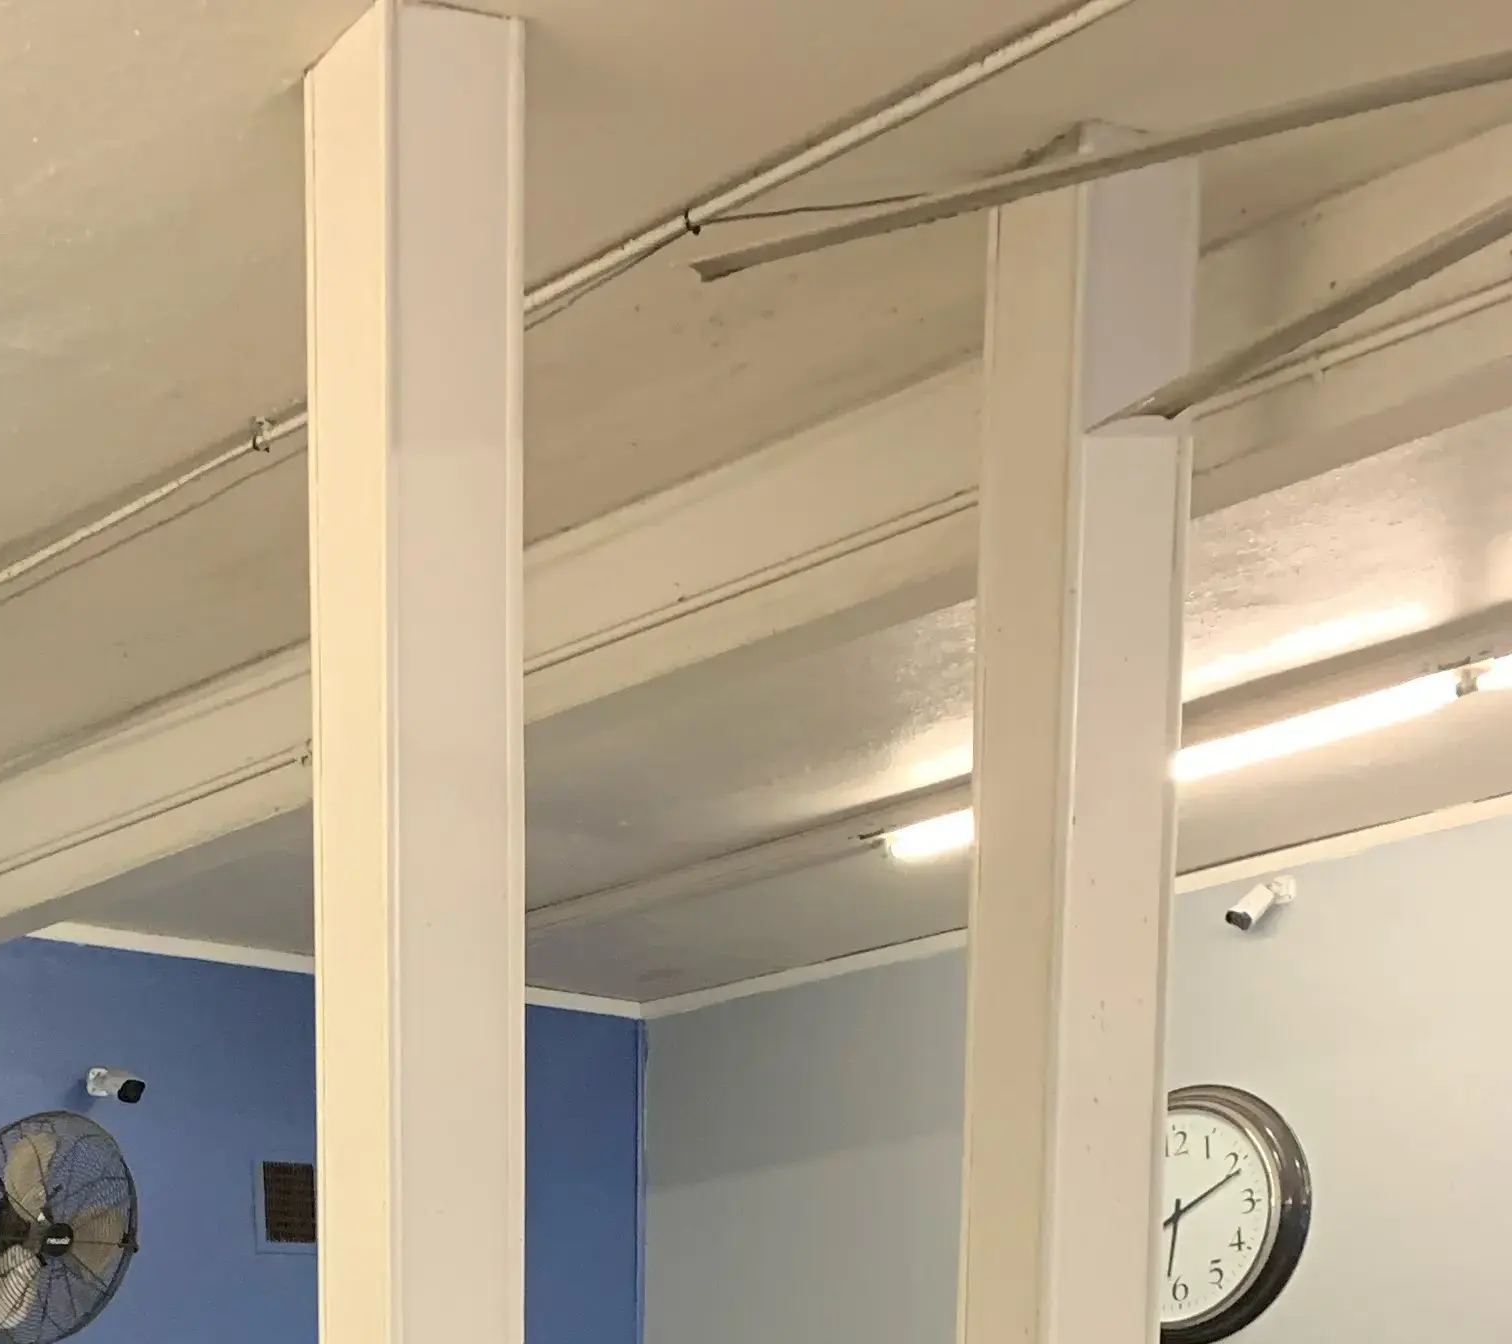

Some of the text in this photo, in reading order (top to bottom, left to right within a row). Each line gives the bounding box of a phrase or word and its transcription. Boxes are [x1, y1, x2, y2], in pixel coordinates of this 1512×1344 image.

[1204, 1135, 1211, 1159] 1
[1224, 1151, 1240, 1179] 2
[1241, 1188, 1257, 1214] 3
[1228, 1226, 1246, 1252] 4
[1208, 1258, 1225, 1286] 5
[1171, 1275, 1189, 1301] 6
